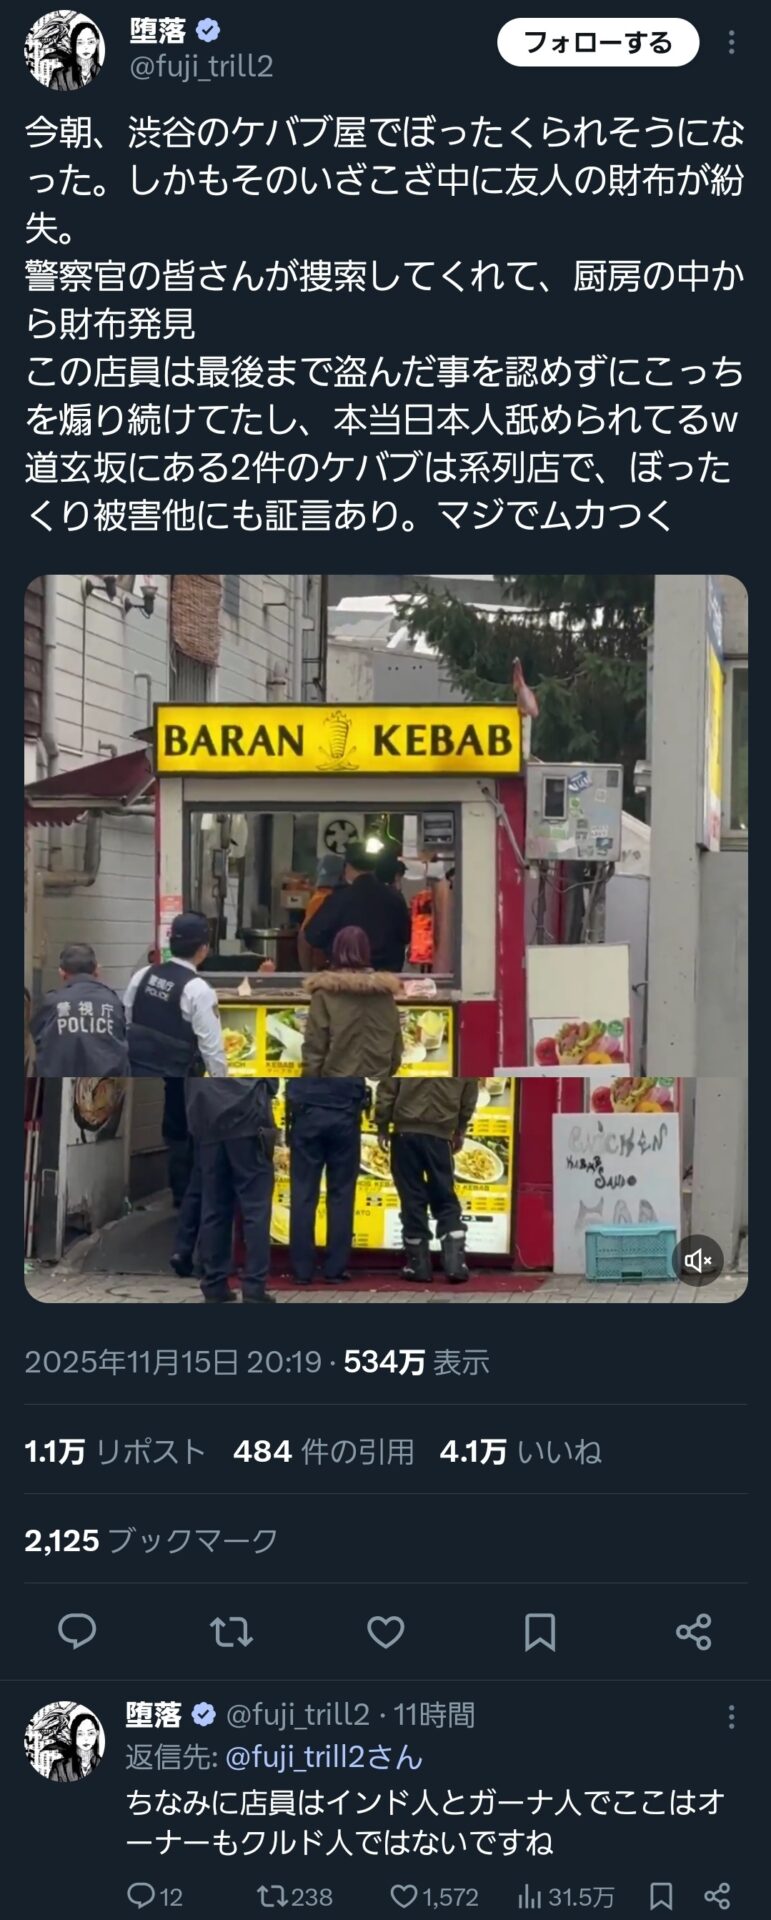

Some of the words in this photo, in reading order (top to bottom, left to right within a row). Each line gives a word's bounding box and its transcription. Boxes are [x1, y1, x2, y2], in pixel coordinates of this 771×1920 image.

[130, 17, 186, 44] 堕落
[526, 31, 672, 55] フォローする
[131, 53, 272, 82] @fuji_trill2
[25, 114, 744, 149] 今朝、渋谷のケバブ屋でぼったくられそうにな
[29, 162, 744, 197] った。しかもそのいざこざ中に友人の財布が紛
[26, 211, 71, 245] 失。
[25, 258, 744, 292] 警察官の皆さんが捜索してくれて、厨房の中か
[29, 307, 195, 340] ら財布発見
[28, 354, 742, 388] この店員は最後まで盗んだ事を認めずにこっち
[27, 403, 738, 436] を煽り続けてたし、本当日本人舐められてるw
[25, 450, 730, 484] 道玄坂にある2件のケバブは系列店で、ぼった
[30, 498, 669, 532] くり被害他にも証言あり。マジでムカつく
[164, 725, 304, 756] BARAN
[374, 725, 513, 756] KEBAB
[144, 986, 169, 1002] POLICE
[57, 1016, 115, 1036] POLICE
[26, 1349, 237, 1376] 2025年11月15日
[248, 1351, 321, 1373] 20:19
[344, 1349, 425, 1376] 534万
[434, 1349, 489, 1375] 表示
[25, 1439, 85, 1465] 1.1万
[99, 1437, 204, 1465] リポスト
[233, 1440, 293, 1462] 484
[301, 1438, 413, 1465] 件の引用
[440, 1439, 507, 1465] 4.1万
[519, 1439, 602, 1464] いいね
[25, 1529, 99, 1556] 2,125
[109, 1527, 276, 1554] ブックマーク
[125, 1701, 182, 1728] 堕落
[227, 1702, 369, 1731] @fuji_trill2
[394, 1701, 474, 1728] 11時間
[126, 1743, 217, 1770] 返信先:
[226, 1744, 422, 1773] @fuji_trill2さん
[127, 1788, 724, 1816] ちなみに店員はインド人とガーナ人でここはオ
[127, 1829, 553, 1856] ーナーもクルド人ではないですね
[160, 1888, 182, 1906] 12
[292, 1888, 332, 1906] 238
[423, 1888, 478, 1909] 1,572
[549, 1887, 614, 1908] 31.5万
